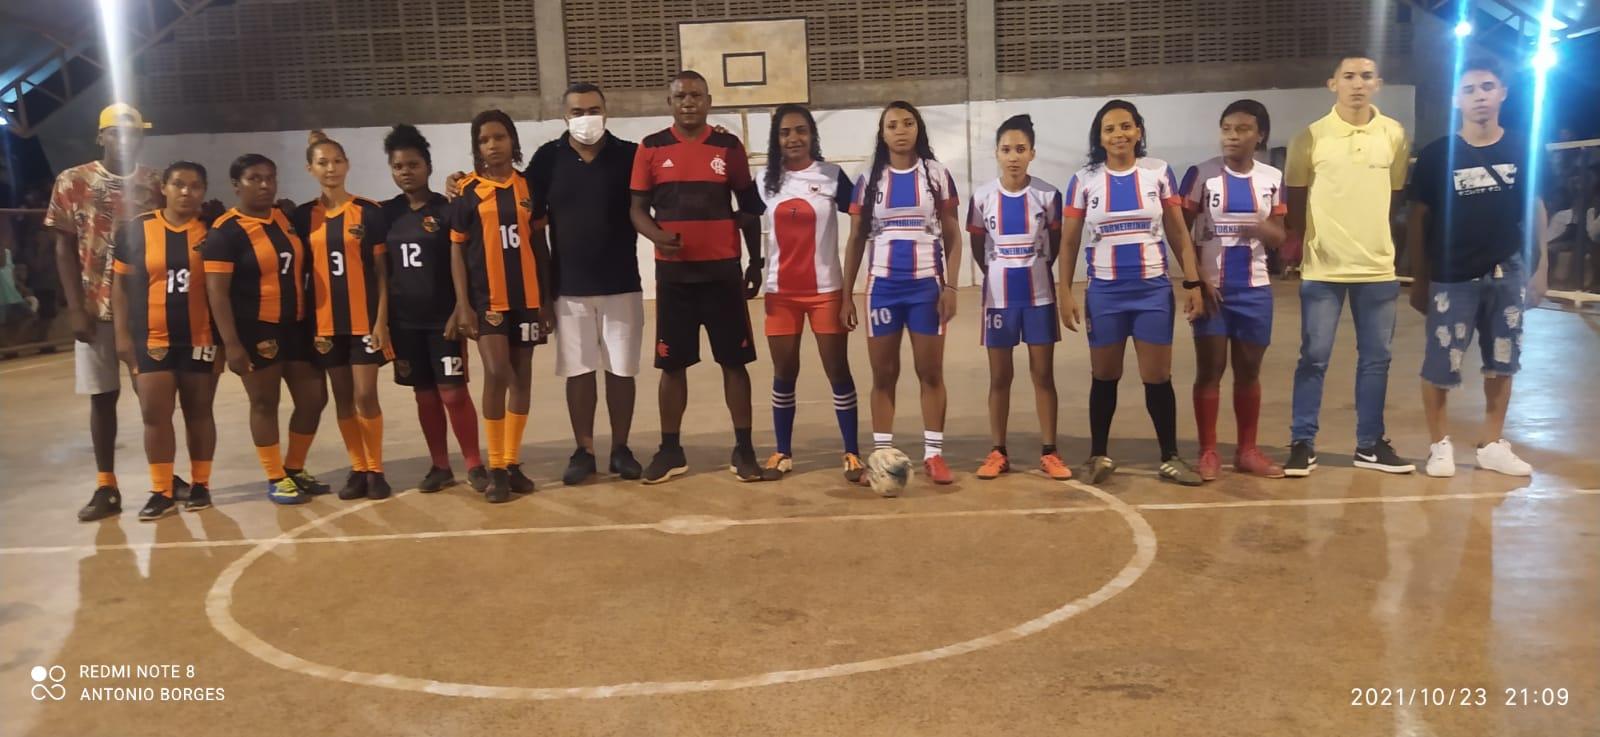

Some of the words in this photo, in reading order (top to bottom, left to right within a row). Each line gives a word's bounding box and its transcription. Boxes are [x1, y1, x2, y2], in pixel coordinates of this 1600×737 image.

[1091, 197, 1100, 209] 9
[499, 224, 521, 249] 16
[279, 252, 293, 274] 7
[330, 251, 344, 276] 3
[400, 243, 423, 268] 12
[167, 268, 191, 293] 19
[870, 307, 892, 326] 10
[986, 313, 1003, 329] 16
[519, 322, 539, 341] 16
[192, 344, 217, 362] 19
[441, 356, 463, 376] 12
